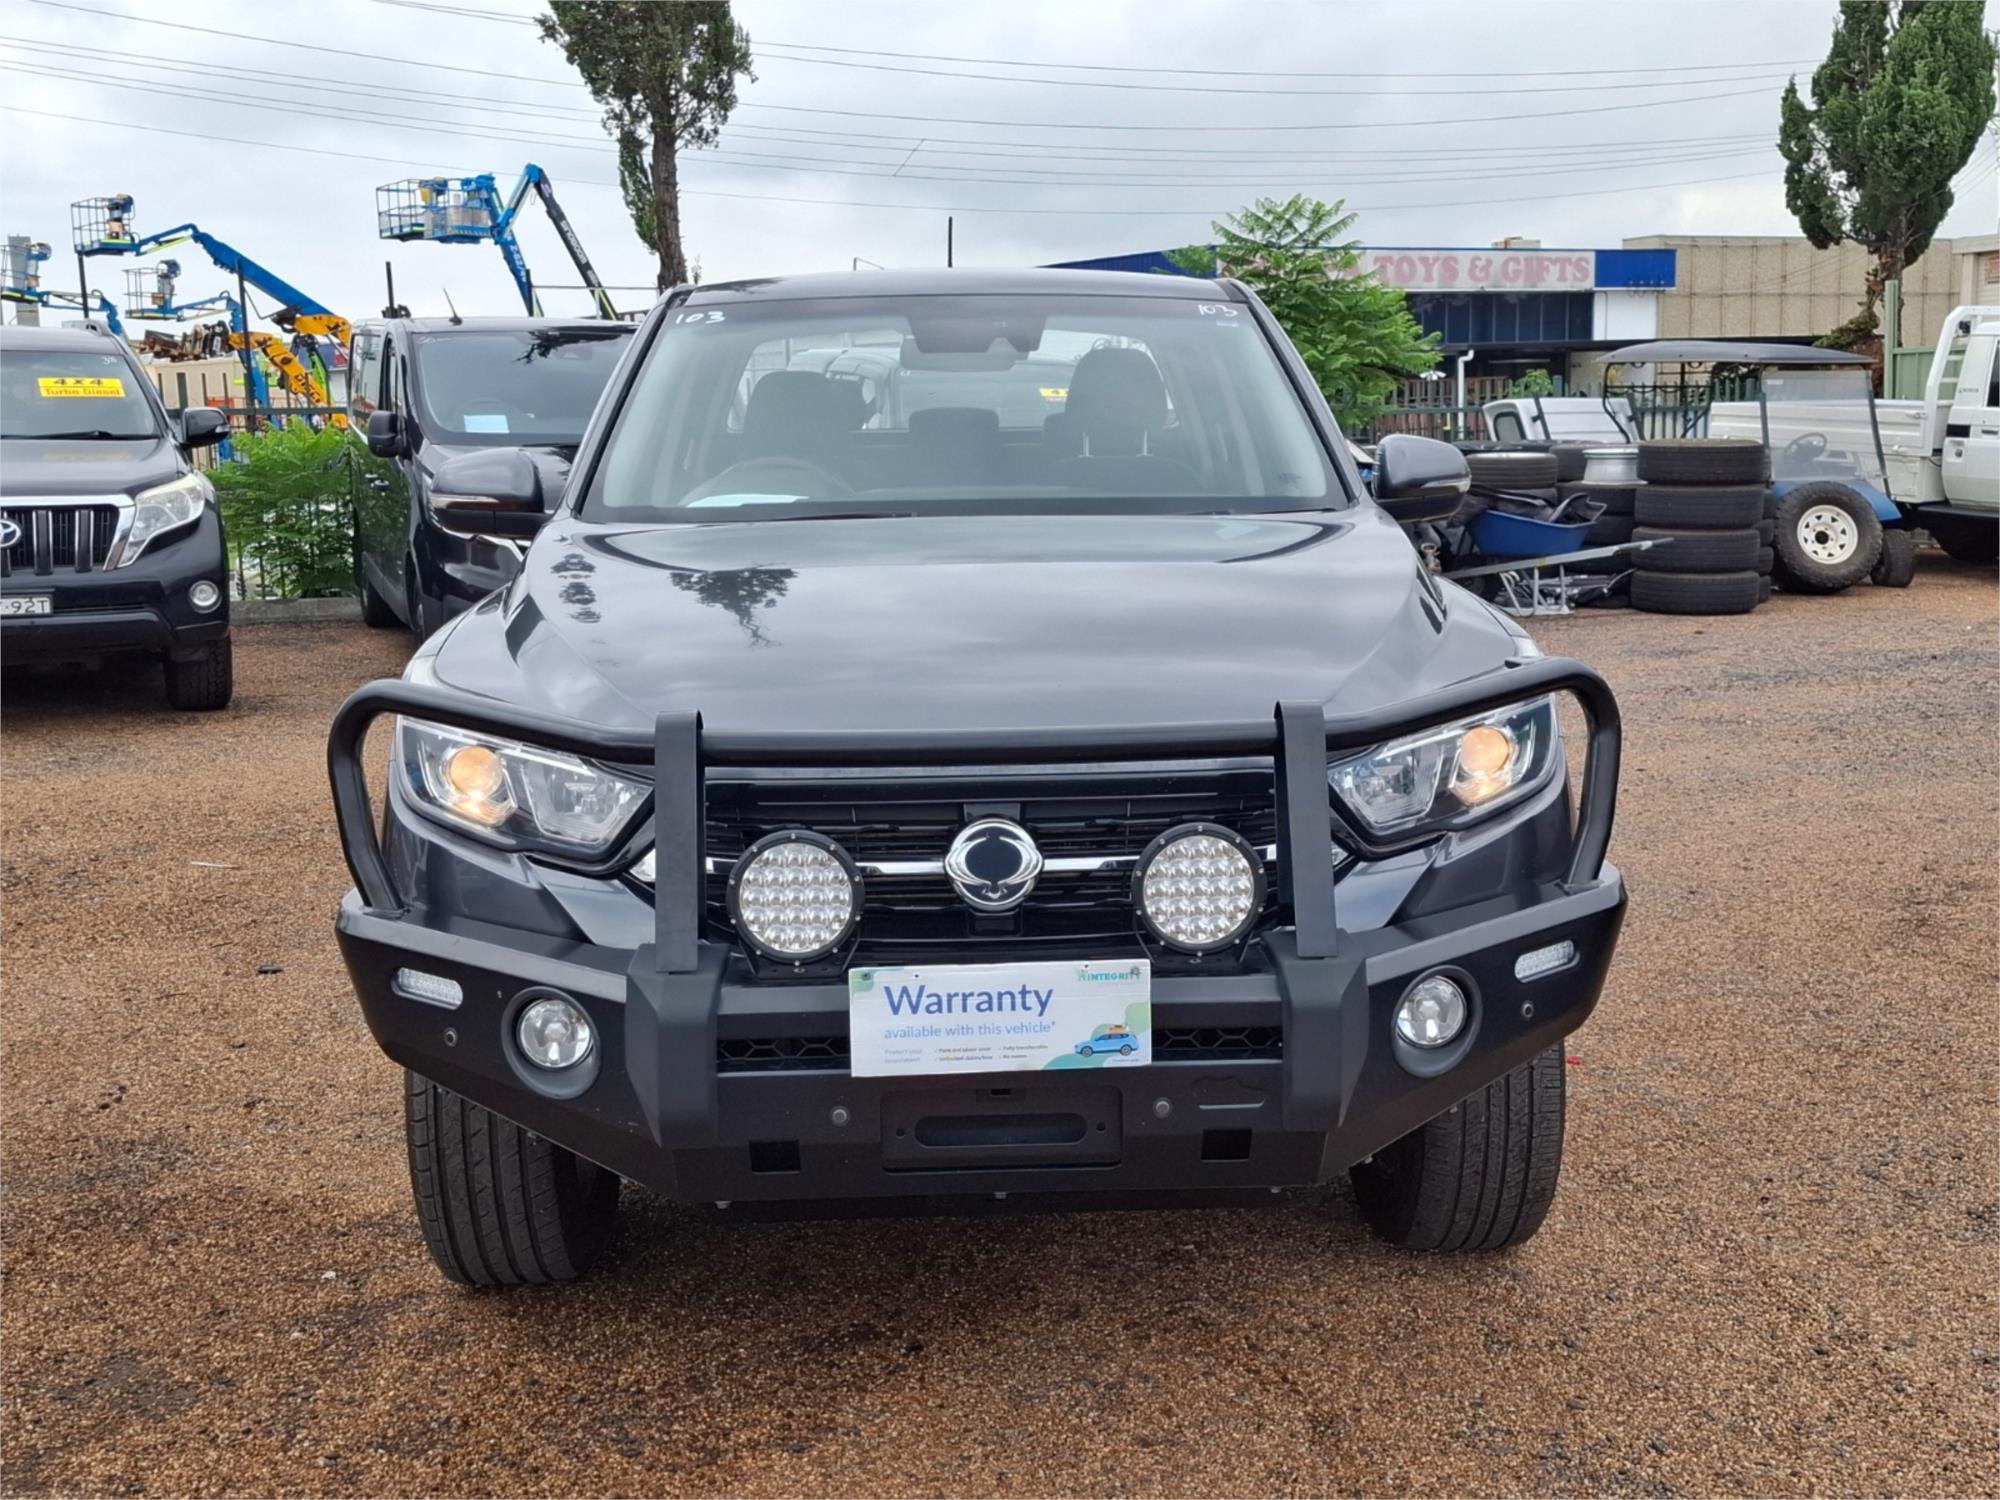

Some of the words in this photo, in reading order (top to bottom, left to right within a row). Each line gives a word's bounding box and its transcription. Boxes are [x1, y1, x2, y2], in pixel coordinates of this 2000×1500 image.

[1373, 255, 1459, 284] TOYS
[1468, 255, 1493, 283] &
[1502, 256, 1590, 283] GIFTS
[675, 311, 725, 324] 103
[1198, 304, 1238, 316] 103
[46, 388, 80, 396] Turbo
[883, 984, 1054, 1017] Warranty
[884, 1025, 941, 1039] available
[945, 1023, 974, 1037] with
[978, 1022, 1001, 1035] this
